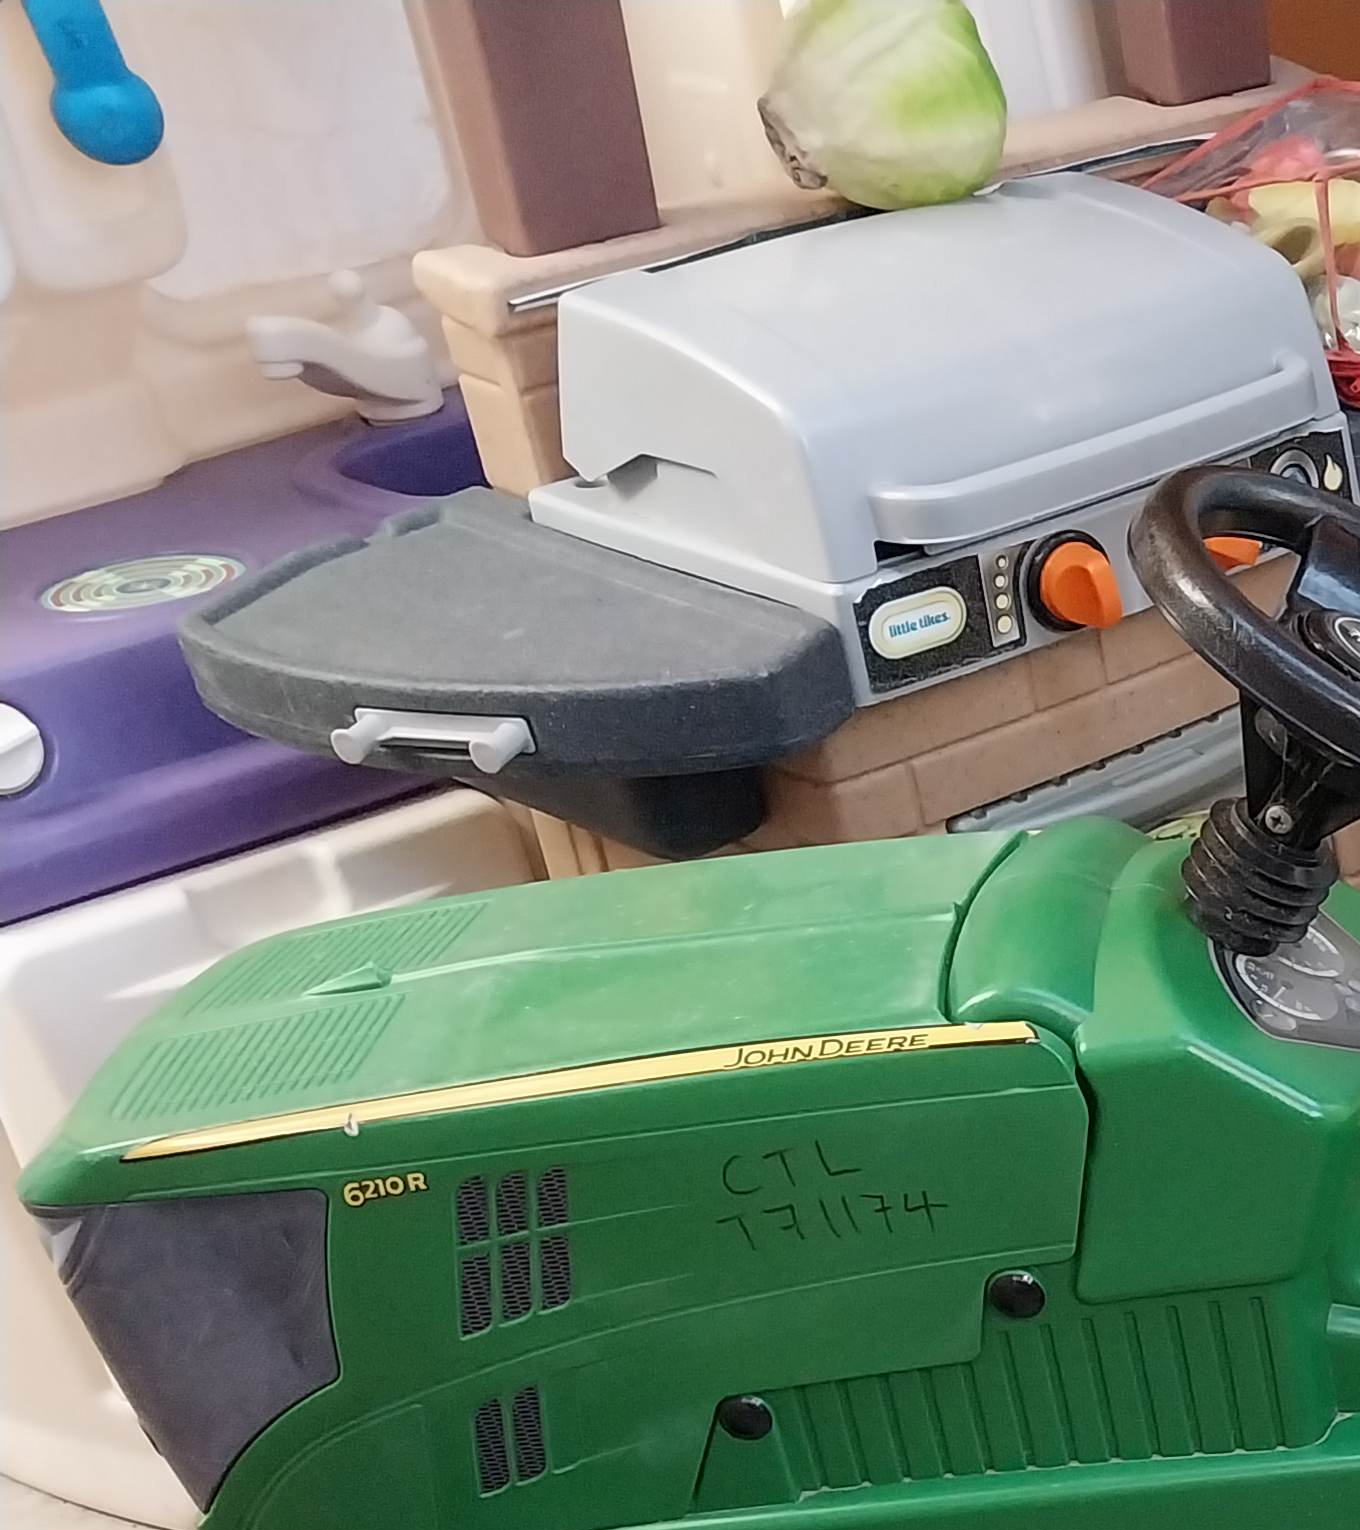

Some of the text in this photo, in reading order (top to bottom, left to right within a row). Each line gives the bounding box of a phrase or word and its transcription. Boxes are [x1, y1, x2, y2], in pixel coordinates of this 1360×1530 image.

[889, 612, 950, 638] little tikes
[724, 1034, 929, 1068] JOHN DEERE
